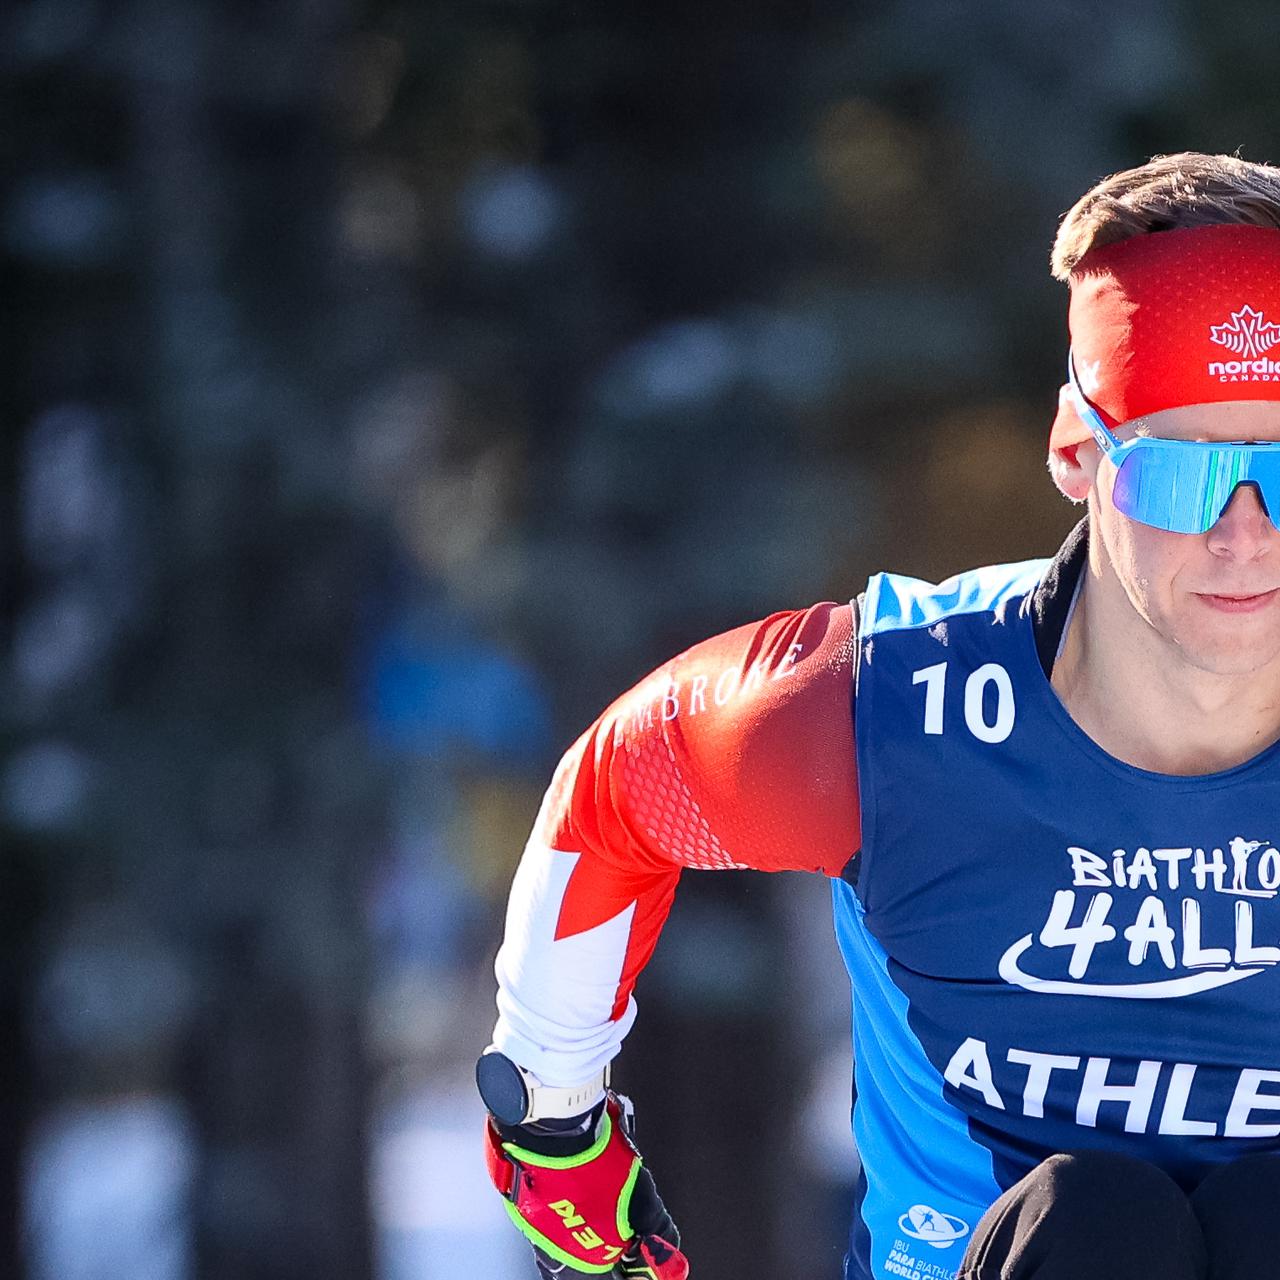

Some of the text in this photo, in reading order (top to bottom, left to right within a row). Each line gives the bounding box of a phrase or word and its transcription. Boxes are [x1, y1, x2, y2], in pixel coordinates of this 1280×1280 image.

[1219, 374, 1280, 382] CANADA
[913, 662, 1016, 744] 10
[547, 1199, 623, 1260] LEKI
[893, 1239, 910, 1253] IBU
[888, 1249, 915, 1268] PARA
